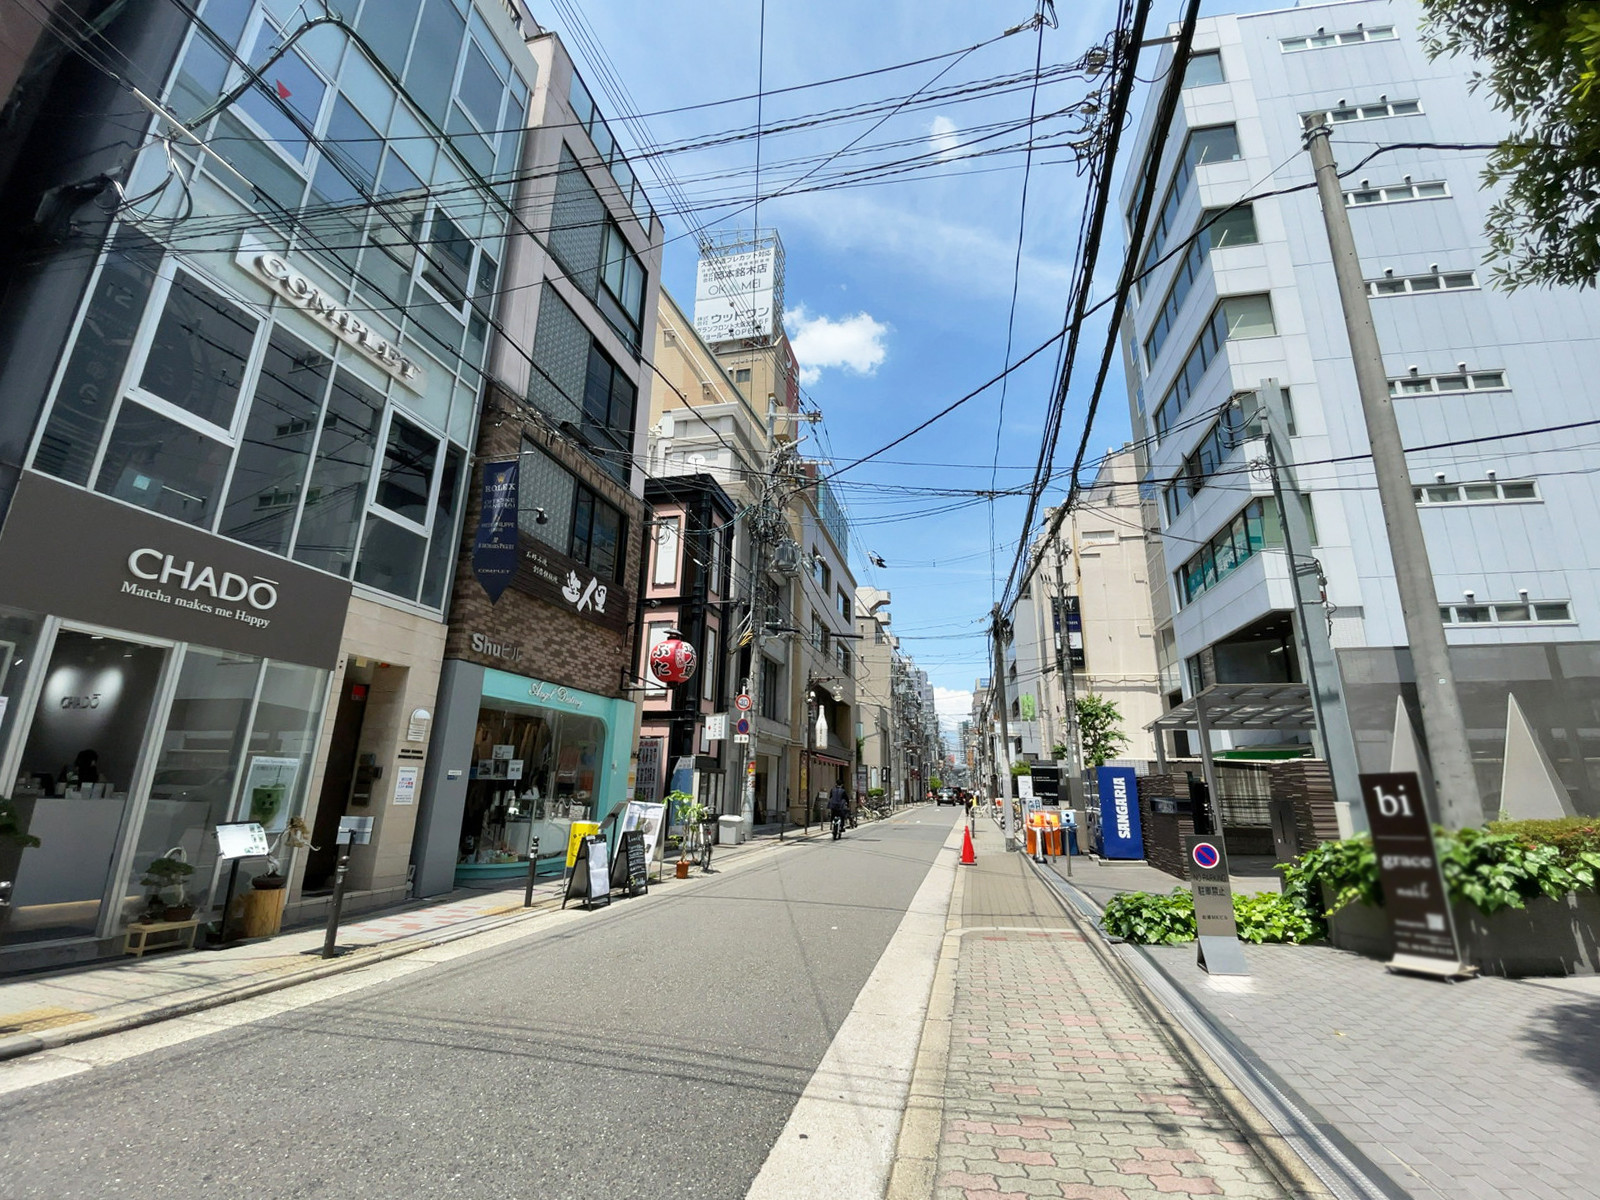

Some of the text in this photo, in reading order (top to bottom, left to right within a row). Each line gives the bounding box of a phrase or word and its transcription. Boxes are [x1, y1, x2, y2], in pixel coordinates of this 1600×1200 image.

[255, 253, 422, 380] COMPLET
[711, 307, 769, 324] ウッドワン
[485, 483, 516, 493] ROLEX
[127, 548, 279, 610] CHADŌ
[121, 580, 271, 629] Matcha makes me Happy
[739, 698, 748, 706] 30
[1113, 777, 1131, 839] SANGARIA
[1373, 784, 1413, 818] bi
[1381, 855, 1432, 870] grace
[1198, 885, 1226, 897] 駐車禁止
